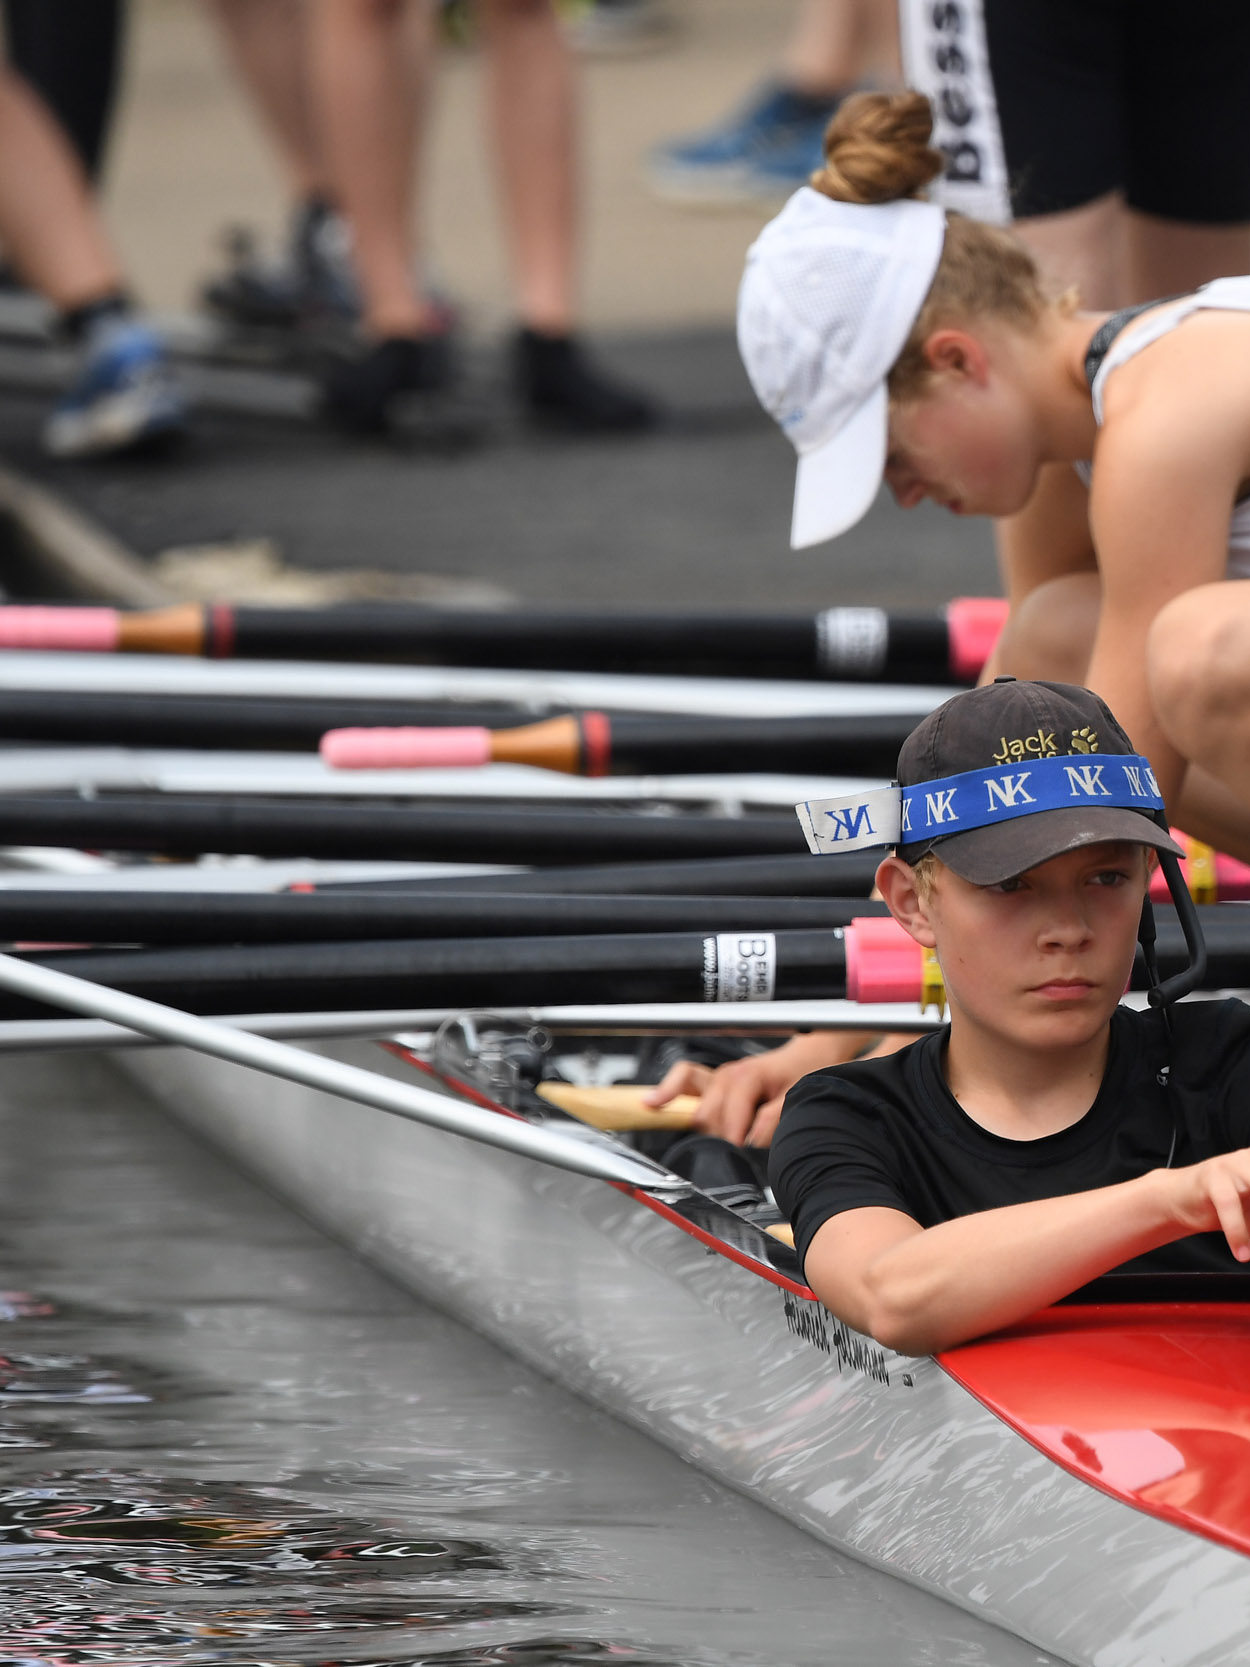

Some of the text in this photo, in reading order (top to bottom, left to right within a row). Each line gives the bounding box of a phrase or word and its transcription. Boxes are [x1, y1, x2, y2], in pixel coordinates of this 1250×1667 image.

[992, 729, 1059, 760] Jack
[925, 787, 960, 826] NK
[983, 771, 1038, 812] NK
[1063, 765, 1113, 796] NK
